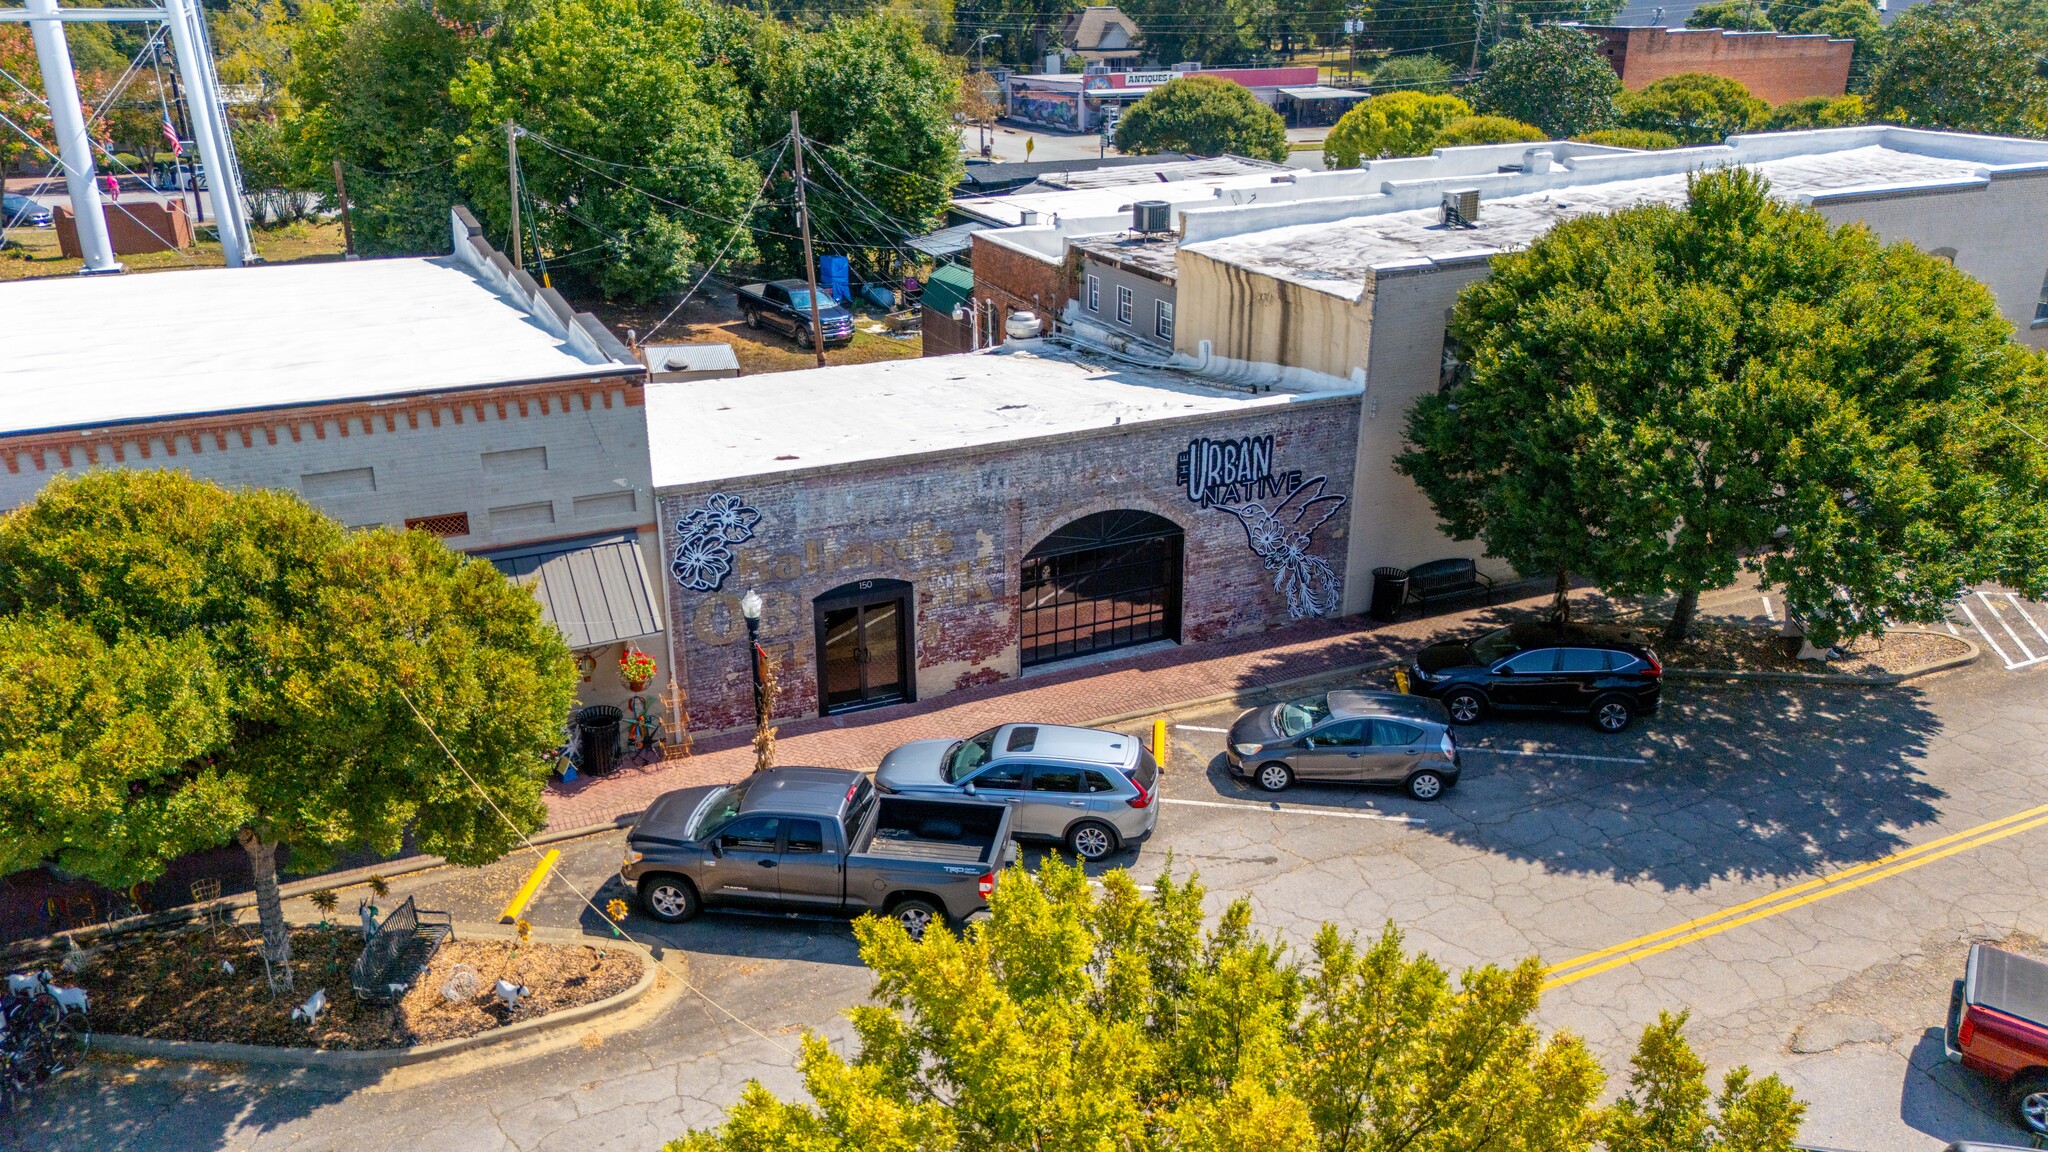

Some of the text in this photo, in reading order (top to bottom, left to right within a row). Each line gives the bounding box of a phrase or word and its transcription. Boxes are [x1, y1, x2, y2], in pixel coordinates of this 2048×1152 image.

[1128, 74, 1167, 83] ANTIQUES
[1179, 453, 1188, 483] THE
[1189, 440, 1270, 499] URBAN
[1203, 473, 1301, 506] NATIVE
[859, 581, 873, 590] 150
